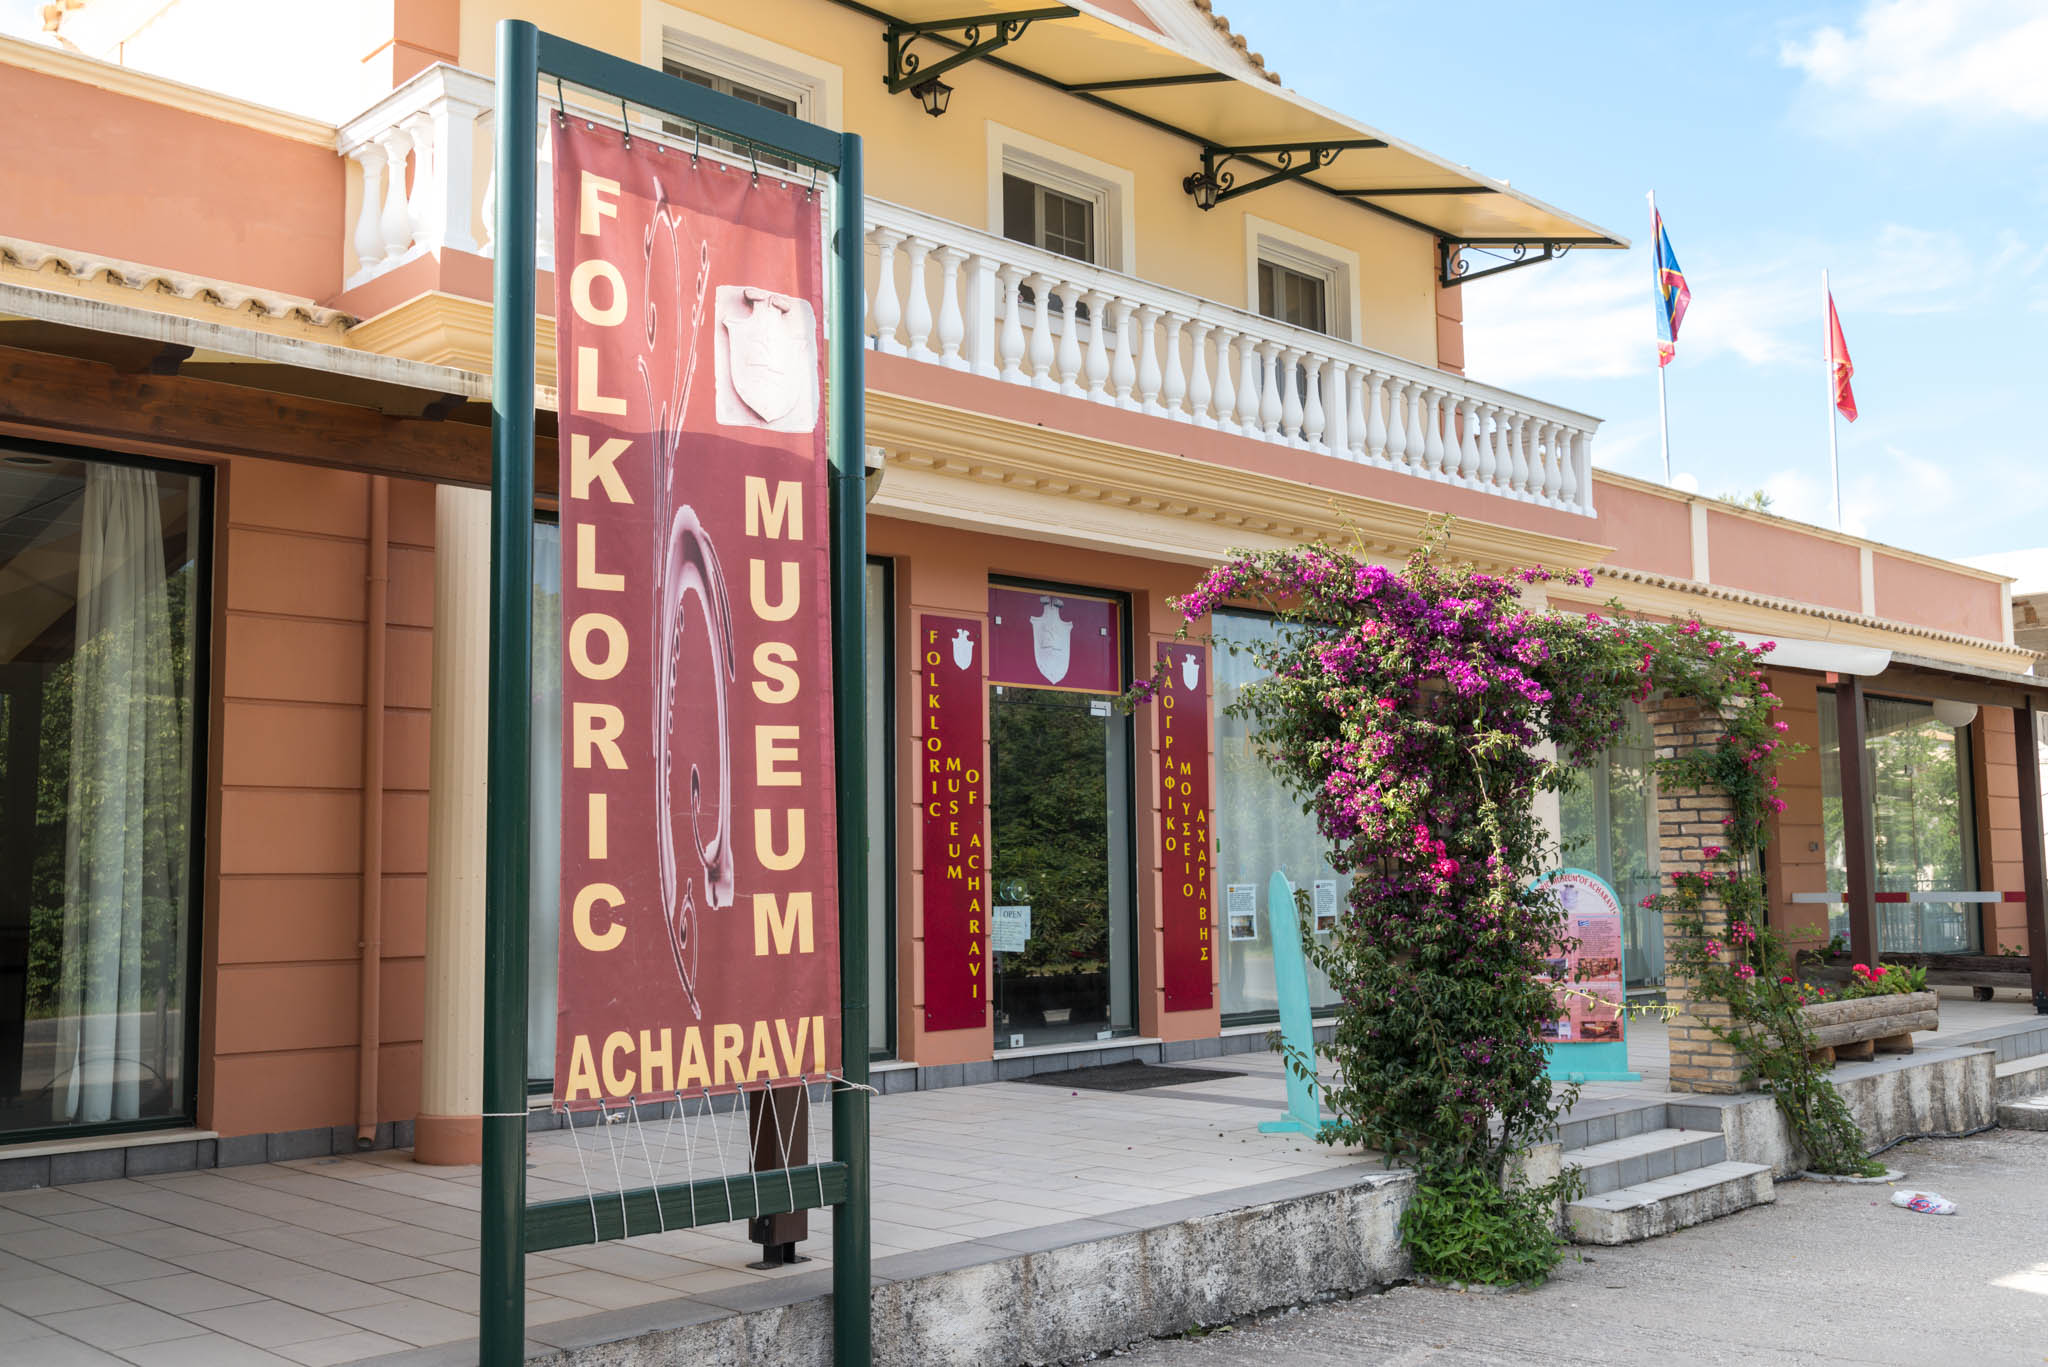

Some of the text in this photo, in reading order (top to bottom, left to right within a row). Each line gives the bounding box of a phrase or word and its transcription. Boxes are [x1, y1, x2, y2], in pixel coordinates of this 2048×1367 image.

[568, 170, 634, 953] FOLKLORIC
[745, 475, 815, 956] MUSEUM
[927, 630, 942, 817] FOLKLORIC
[1164, 655, 1177, 851] ΛΑΟΓΡΑΦΙΚΟ
[946, 757, 963, 880] MUSEUM
[965, 769, 981, 999] OF ACHARAVI
[1180, 762, 1194, 897] ΜΟΥΣΕΙΟ
[1196, 809, 1209, 961] ΑΧΑΡΑΒΗΣ
[1002, 910, 1022, 919] OPEN
[565, 1015, 826, 1101] ACHARAVI
